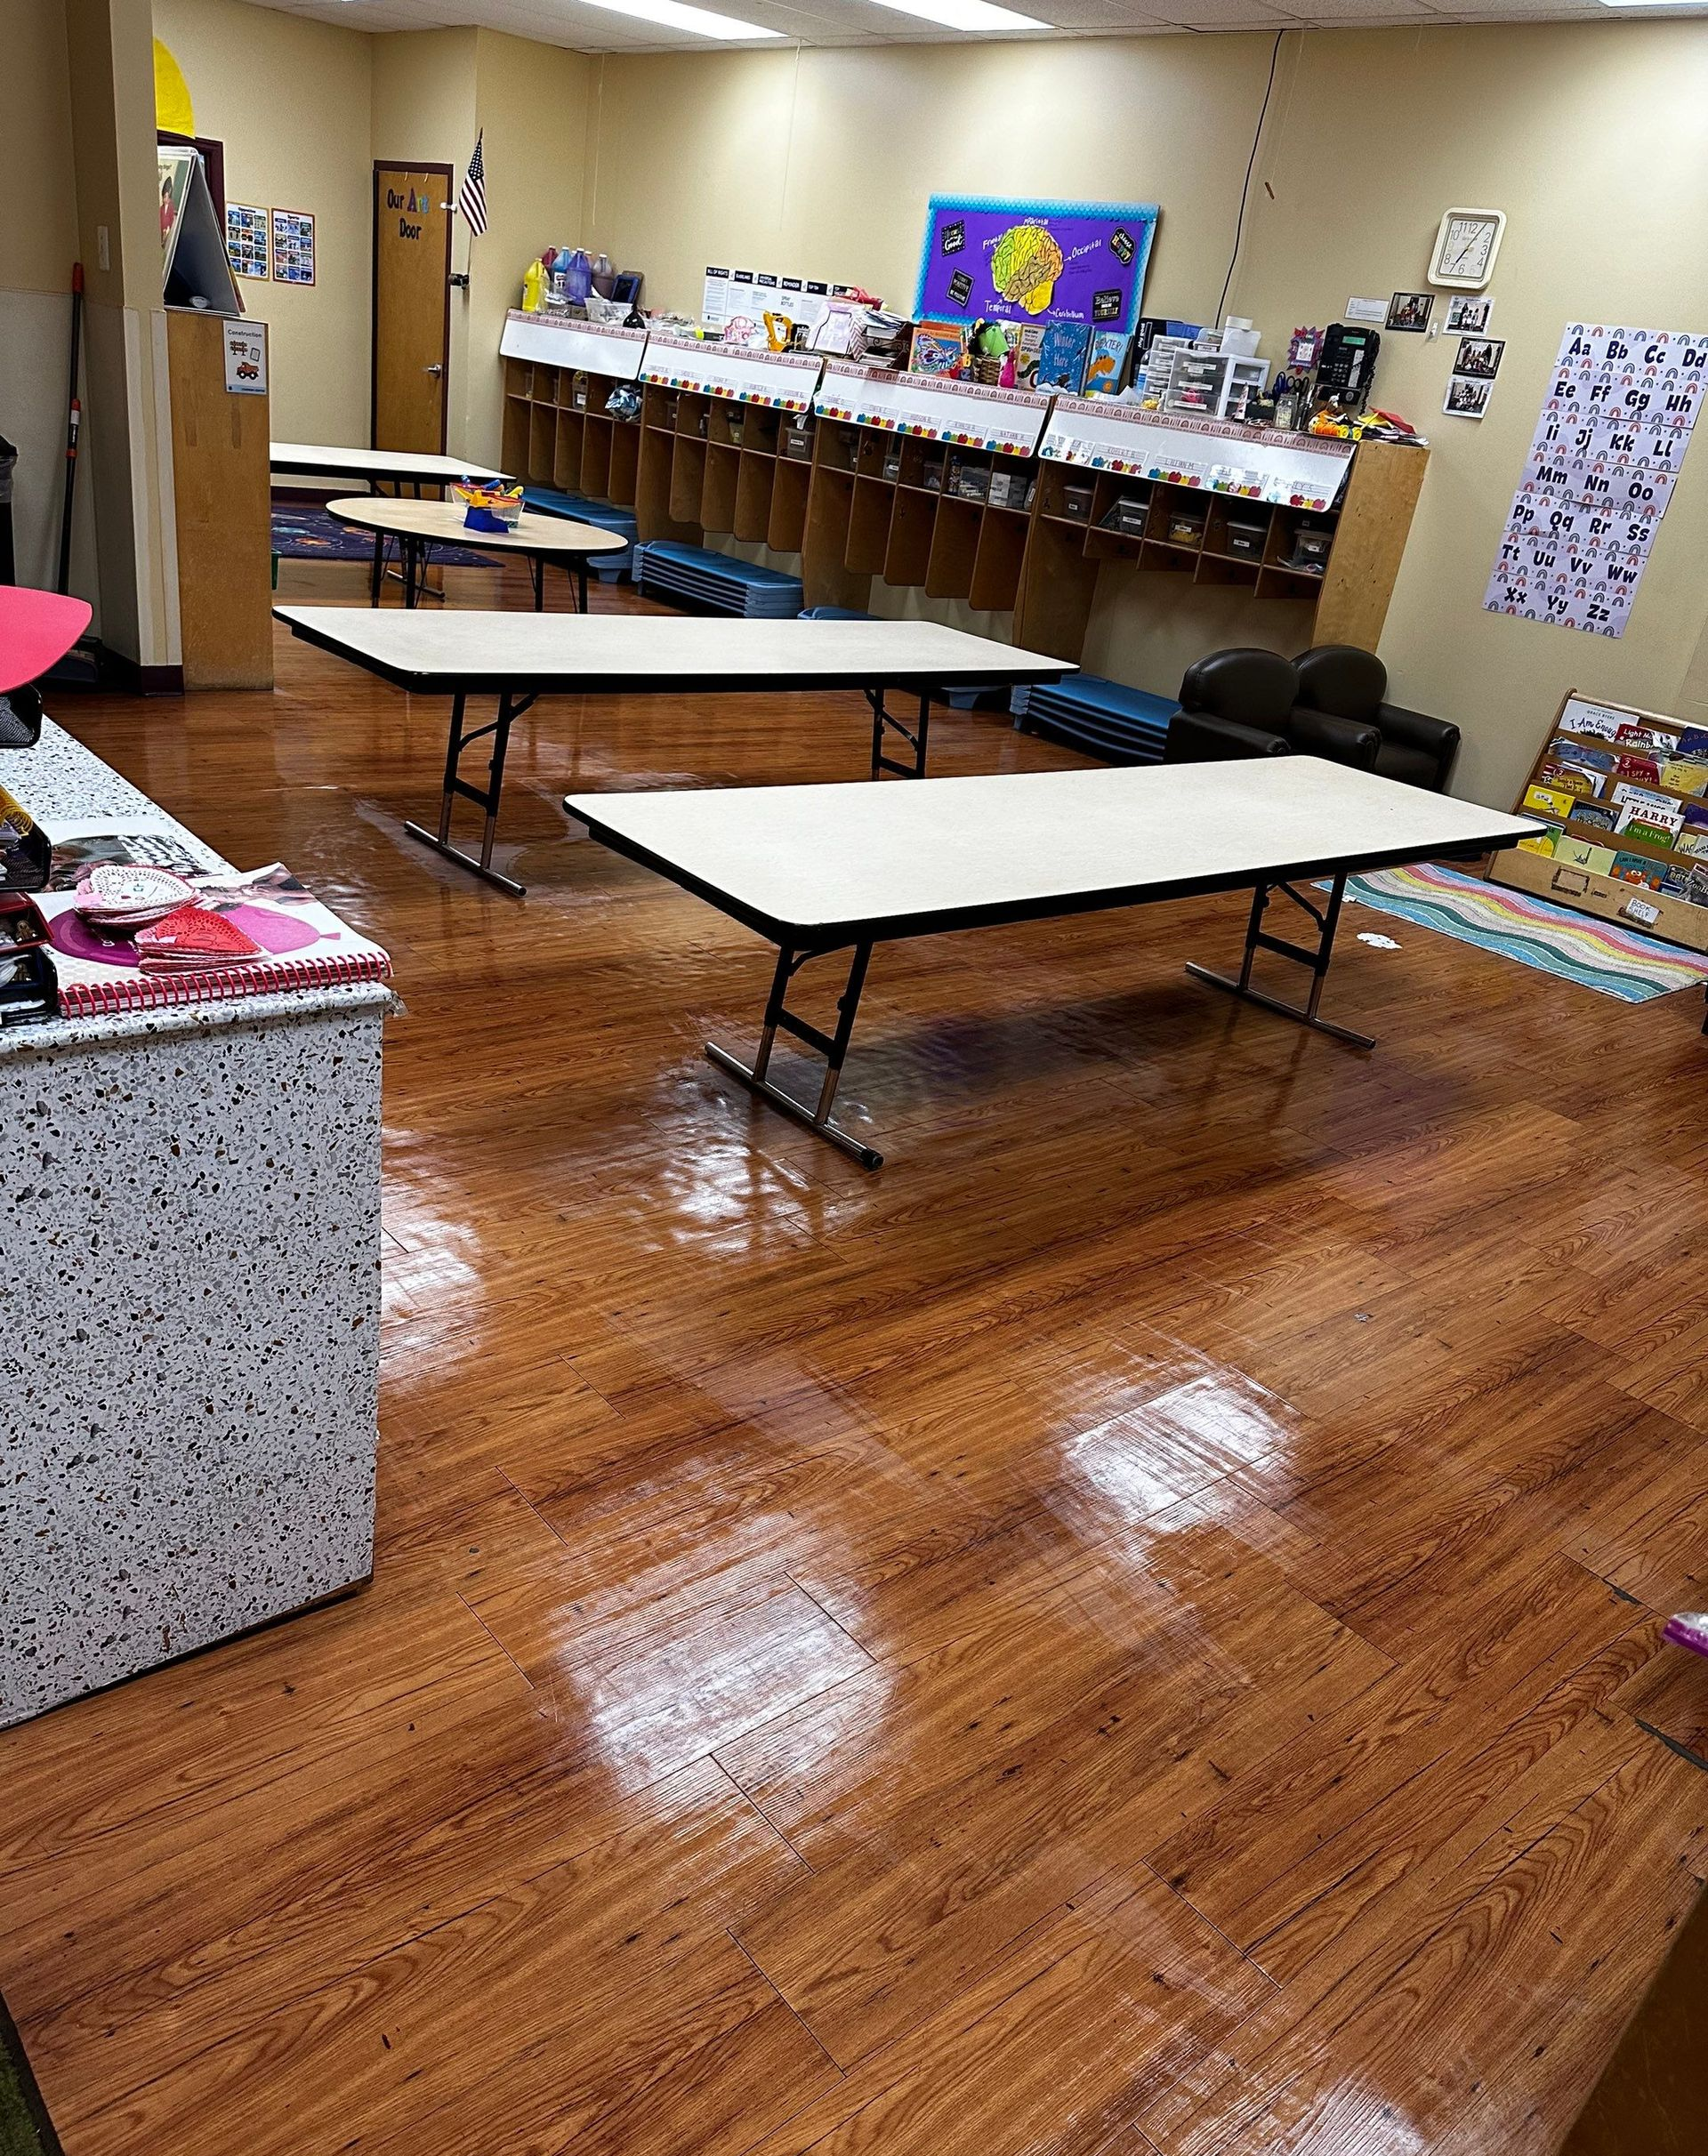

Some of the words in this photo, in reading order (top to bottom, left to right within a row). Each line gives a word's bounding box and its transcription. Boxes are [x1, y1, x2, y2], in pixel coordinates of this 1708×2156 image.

[387, 188, 405, 210] Our
[407, 187, 429, 213] Art
[399, 217, 423, 240] Door
[1459, 221, 1468, 233] 11
[1468, 222, 1478, 234] 12
[1451, 229, 1460, 241] 10
[1484, 232, 1491, 244] 2
[1072, 238, 1101, 258] Occipital
[1480, 245, 1488, 256] 3
[1444, 253, 1452, 264] 8
[1477, 257, 1484, 267] 4
[1458, 264, 1466, 275] 6
[984, 300, 1012, 314] Temporal
[228, 329, 262, 338] Construction
[1568, 337, 1591, 356] Aa
[1607, 342, 1628, 359] Bb
[1645, 346, 1665, 364] Cc
[1682, 350, 1706, 368] Dd
[1555, 381, 1575, 398] Ee
[1590, 385, 1611, 402] Ff
[1625, 390, 1650, 411] Gg
[1665, 394, 1691, 413] Hh
[1546, 424, 1559, 440] Ii
[1575, 429, 1593, 450] Jj
[1609, 434, 1635, 452] Kk
[1653, 440, 1672, 457] Ll
[1536, 465, 1568, 485] Mm
[1584, 475, 1609, 492] Nn
[1628, 483, 1653, 501] Oo
[1513, 505, 1535, 524] Pp
[1550, 511, 1574, 532] Qq
[1589, 517, 1612, 535] Rr
[1627, 524, 1649, 542] Ss
[1503, 544, 1520, 561] Tt
[1533, 551, 1556, 567] Uu
[1570, 558, 1592, 575] Vv
[1607, 565, 1638, 583] Ww
[1504, 587, 1527, 604] Xx
[1547, 596, 1568, 615] Yy
[1587, 604, 1609, 621] Zz
[1569, 719, 1575, 729] I
[1577, 717, 1595, 728] Am
[1595, 719, 1617, 739] Enoug
[1623, 728, 1642, 738] Light
[1625, 738, 1654, 749] Rainb
[1629, 805, 1679, 827] HARRY
[1629, 825, 1640, 834] I'm
[1629, 905, 1650, 918] SHELF
[1631, 899, 1652, 912] BOOK
